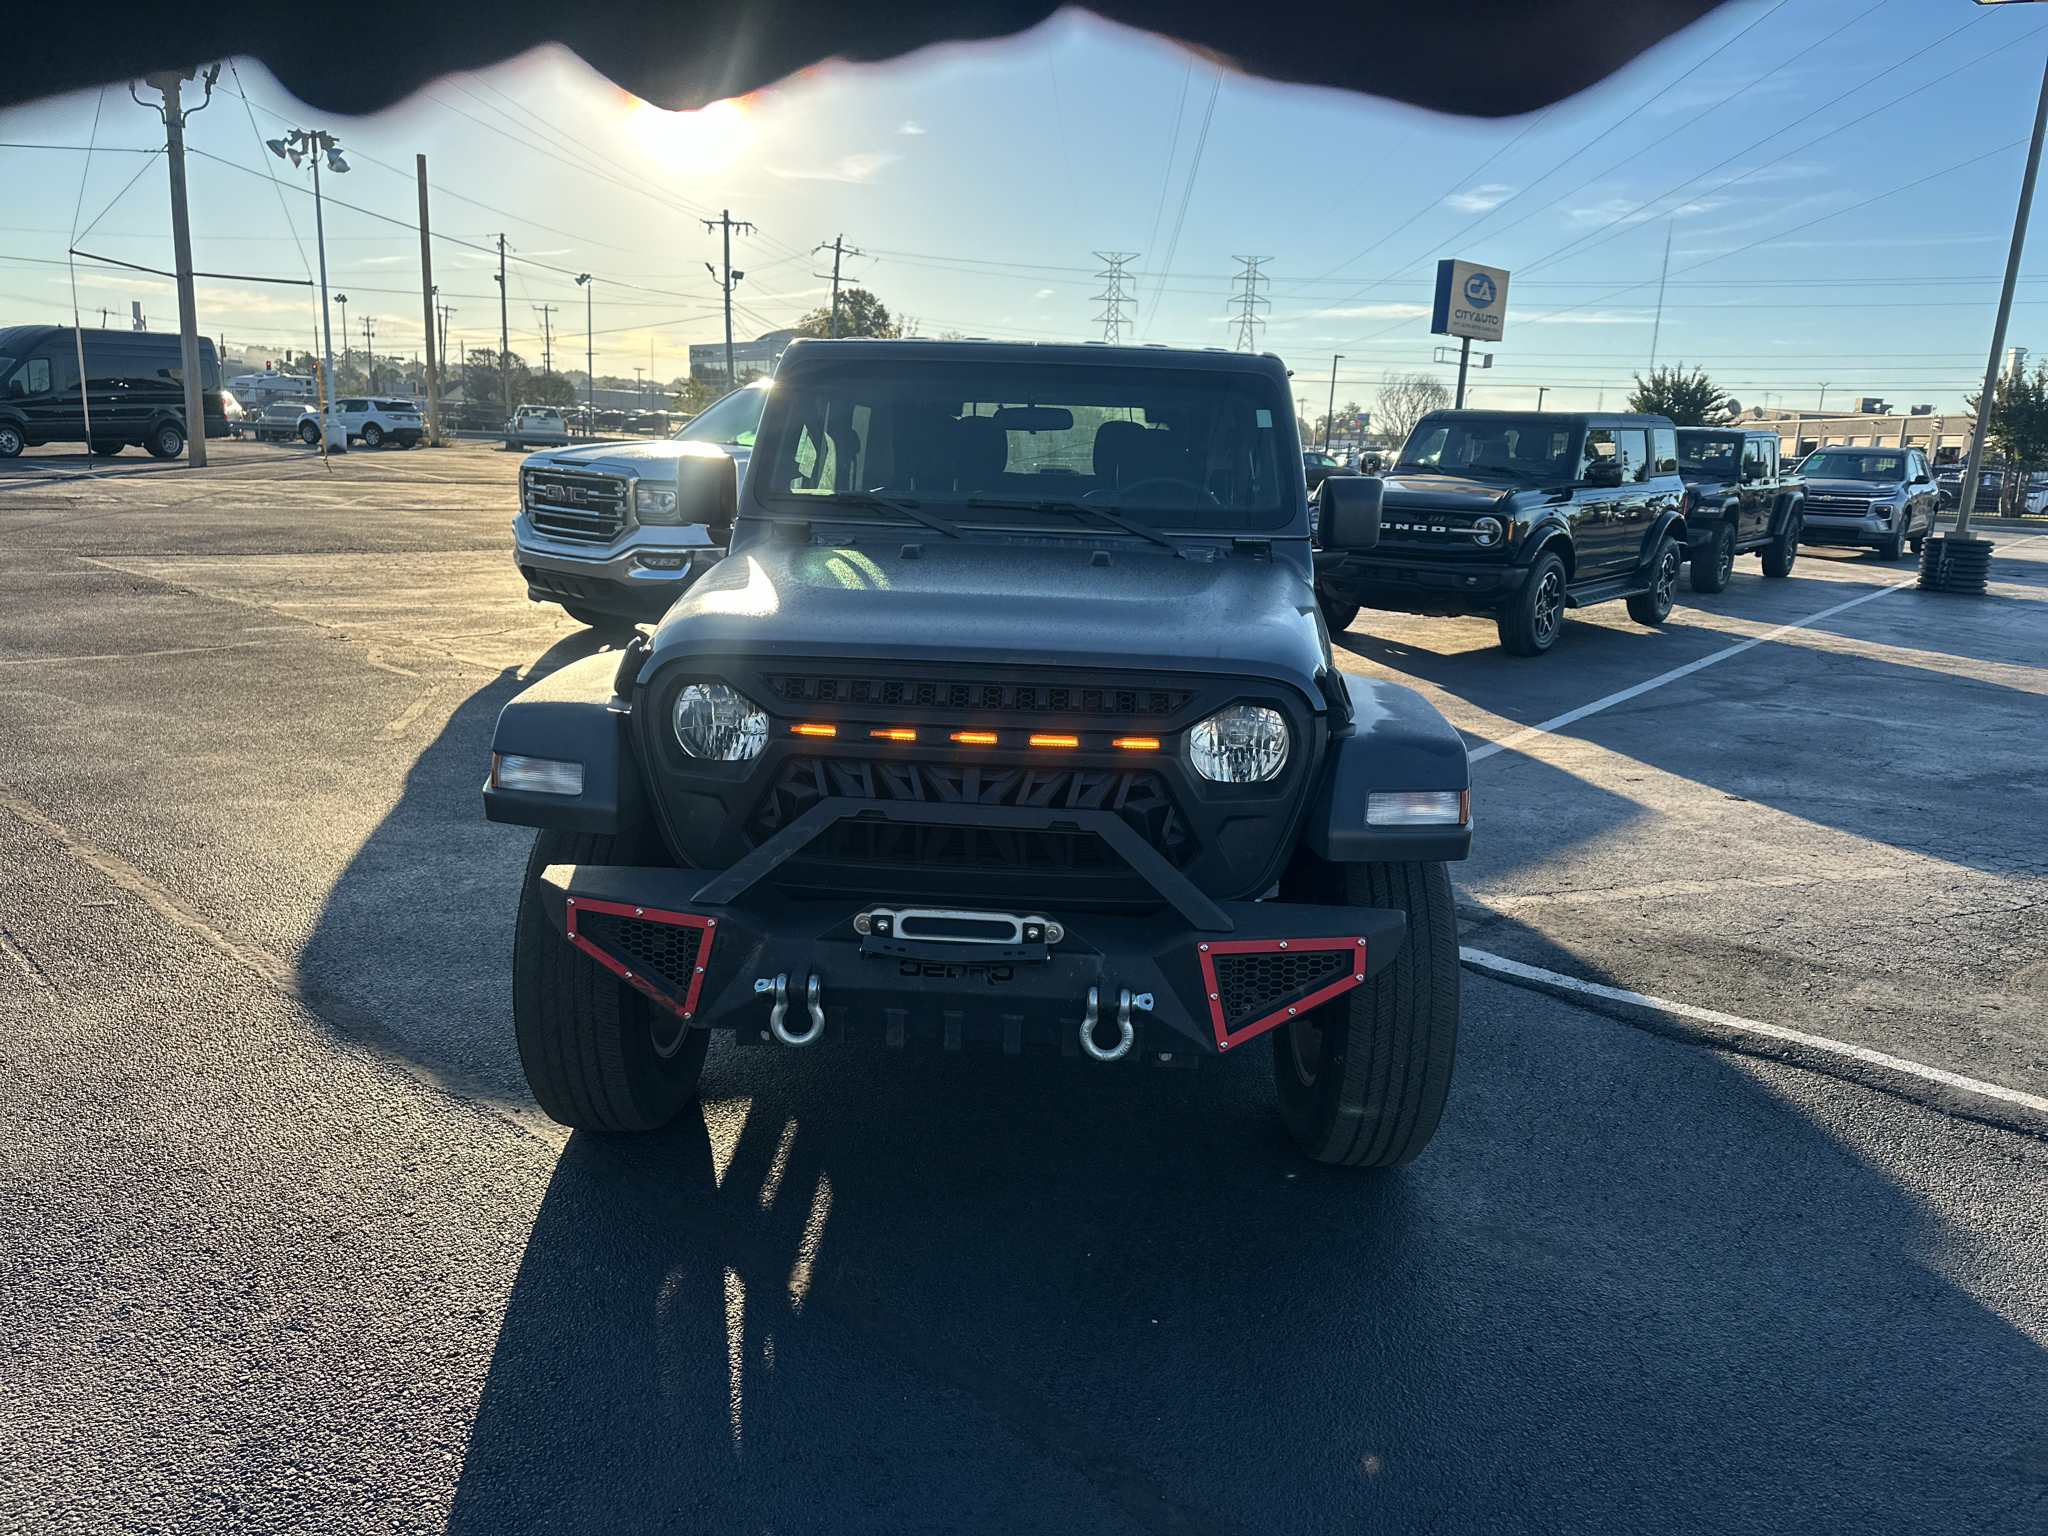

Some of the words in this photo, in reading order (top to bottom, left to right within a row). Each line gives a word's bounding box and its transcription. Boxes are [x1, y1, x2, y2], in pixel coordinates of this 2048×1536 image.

[1466, 278, 1492, 301] CA
[545, 484, 587, 504] GMC
[1380, 522, 1446, 533] ONCO
